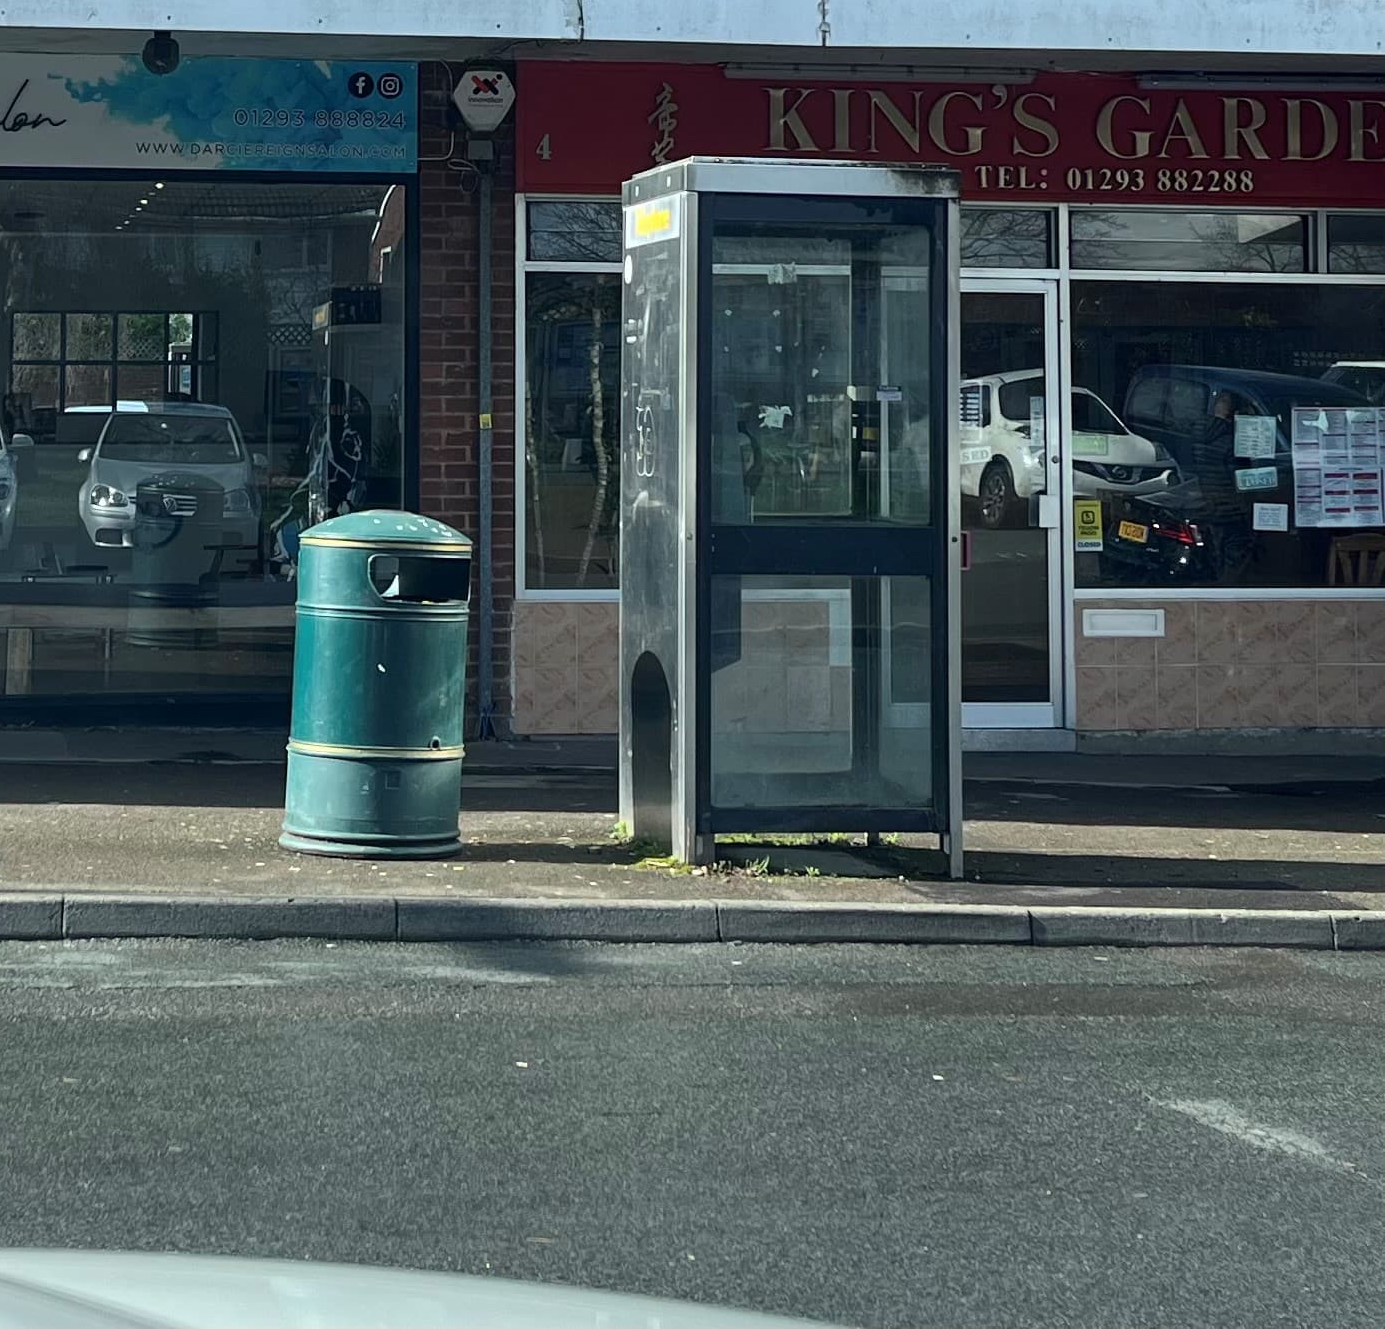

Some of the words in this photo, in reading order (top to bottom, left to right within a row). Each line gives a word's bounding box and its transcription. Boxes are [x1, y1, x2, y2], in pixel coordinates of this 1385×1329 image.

[233, 108, 305, 127] 01293
[314, 110, 406, 129] 888824
[763, 84, 1059, 157] KING'S
[1095, 95, 1385, 162] GARDE
[536, 134, 552, 160] 4
[975, 166, 1049, 189] TEL:
[1066, 169, 1145, 191] 01293
[1157, 170, 1255, 193] 882288
